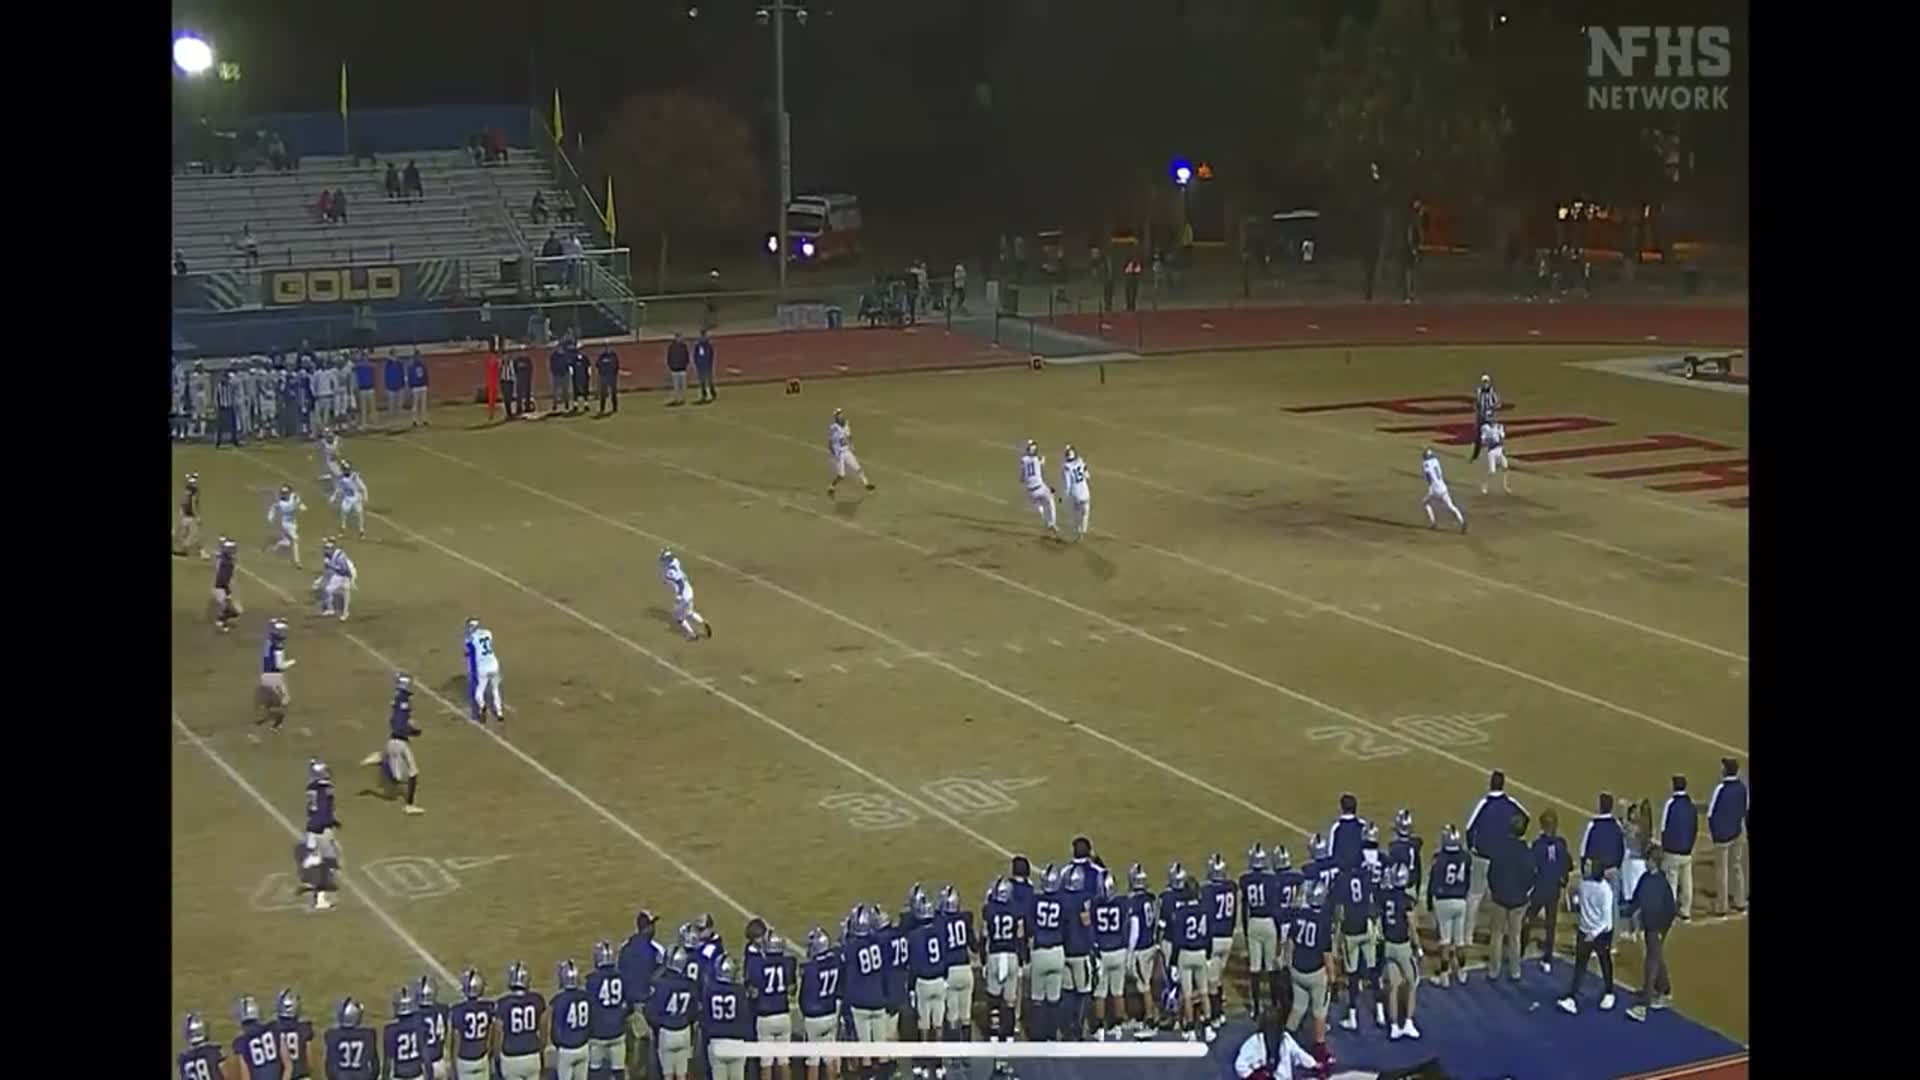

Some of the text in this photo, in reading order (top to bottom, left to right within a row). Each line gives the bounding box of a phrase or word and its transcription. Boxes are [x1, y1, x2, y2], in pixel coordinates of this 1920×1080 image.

[272, 266, 401, 303] GOLD
[819, 776, 1018, 830] 30
[1445, 861, 1466, 885] 64
[1247, 882, 1265, 907] 81
[1350, 878, 1363, 902] 8
[1036, 902, 1060, 927] 52
[1216, 892, 1234, 919] 78
[1386, 900, 1396, 925] 2
[993, 915, 1013, 940] 12
[1096, 907, 1121, 932] 53
[1185, 914, 1208, 940] 24
[1295, 918, 1317, 947] 70
[858, 945, 882, 974] 88
[928, 937, 941, 964] 9
[599, 978, 622, 1006] 49
[764, 965, 786, 994] 71
[818, 968, 838, 997] 77
[566, 1000, 589, 1029] 48
[666, 991, 691, 1016] 47
[711, 994, 736, 1019] 63
[464, 1011, 488, 1039] 32
[510, 1005, 537, 1034] 60
[249, 1032, 277, 1066] 68
[338, 1041, 364, 1068] 37
[397, 1033, 419, 1060] 21
